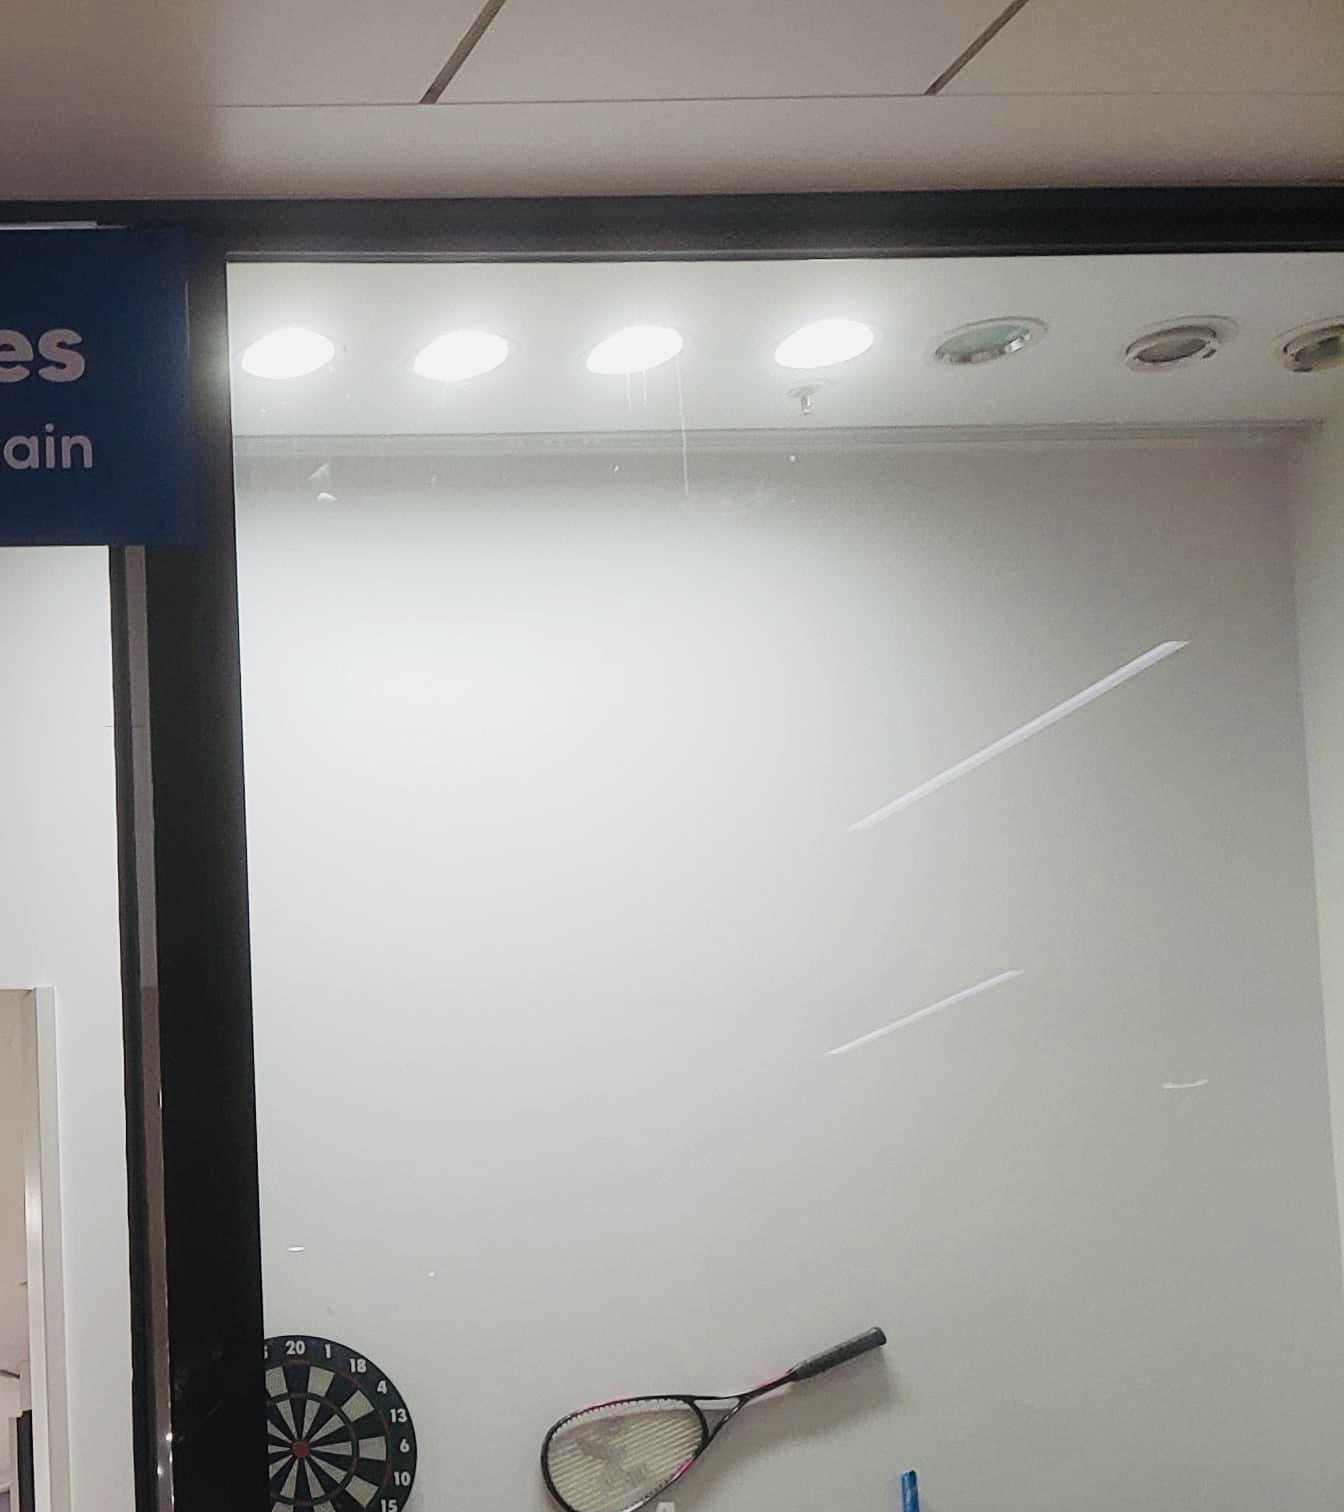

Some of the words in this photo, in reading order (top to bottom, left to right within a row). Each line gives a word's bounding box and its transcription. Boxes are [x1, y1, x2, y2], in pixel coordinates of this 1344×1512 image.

[285, 1340, 306, 1356] 20
[325, 1343, 331, 1358] 1
[350, 1358, 367, 1373] 18
[376, 1380, 388, 1394] 4
[390, 1408, 407, 1423] 13
[399, 1438, 410, 1453] 6
[394, 1471, 411, 1486] 10
